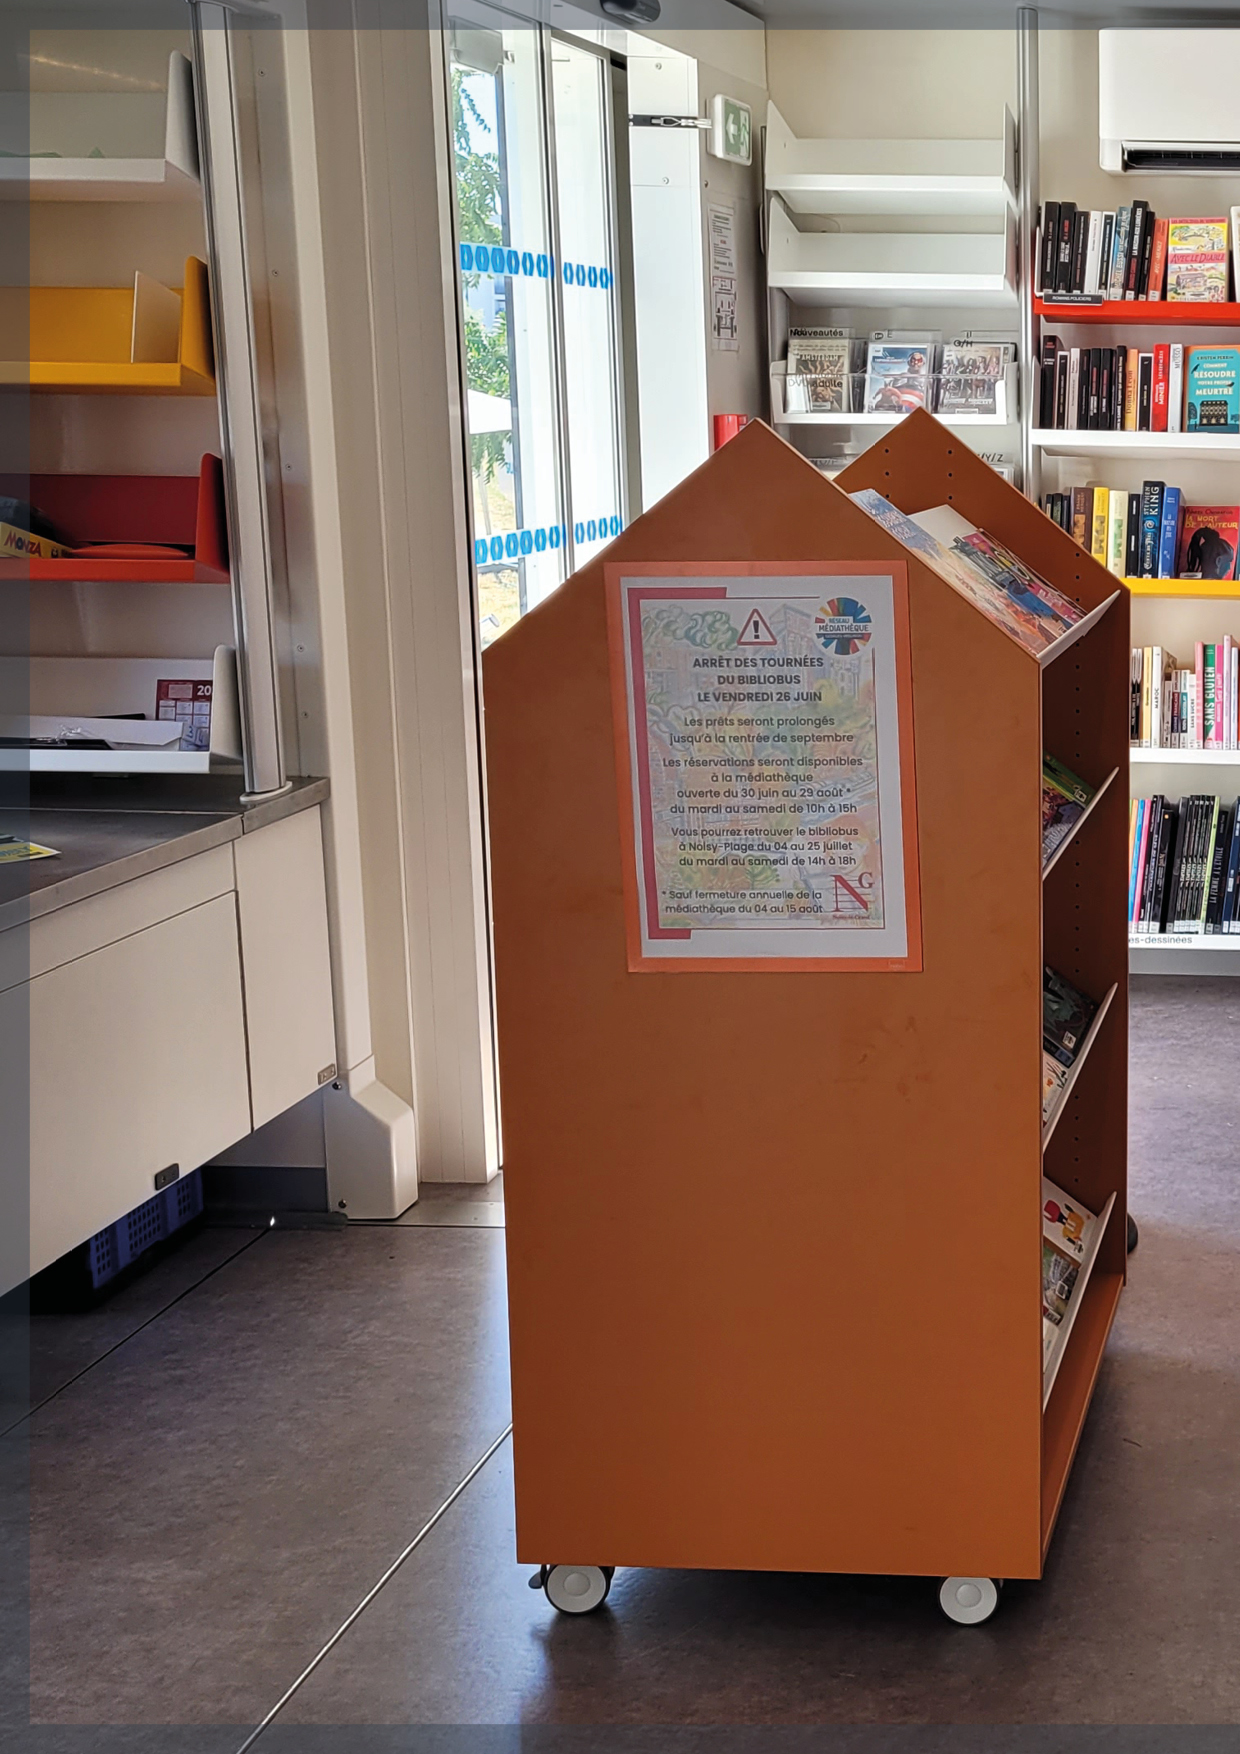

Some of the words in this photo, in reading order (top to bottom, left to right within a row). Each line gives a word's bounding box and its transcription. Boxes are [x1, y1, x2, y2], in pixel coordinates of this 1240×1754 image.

[1170, 254, 1187, 264] AVEC
[1188, 254, 1199, 263] LE
[1200, 253, 1225, 262] DIABLE
[790, 328, 844, 336] Nouveautés
[1196, 386, 1233, 395] MEURTRE
[1150, 487, 1159, 515] KING
[1199, 521, 1238, 529] L'AUTEUR
[4, 529, 42, 557] MONZA
[819, 623, 869, 631] MÉDIATHÈQUE
[693, 656, 731, 668] ARRÊT
[734, 658, 757, 667] DES
[762, 655, 823, 667] TOURNÉES
[718, 675, 734, 684] DU
[738, 675, 800, 684] BIBLIOBUS
[1205, 667, 1215, 698] GLUTEN
[698, 692, 710, 702] LE
[713, 692, 774, 701] VENDREDI
[776, 692, 791, 701] 26
[794, 692, 821, 701] JUIN
[1204, 703, 1215, 725] SANS
[684, 717, 702, 727] Les
[706, 717, 734, 729] prêts
[738, 717, 774, 726] seront
[777, 716, 835, 728] prolongés
[670, 734, 711, 746] jusqu'à
[715, 734, 725, 743] la
[729, 734, 769, 743] rentrée
[773, 734, 787, 743] de
[790, 733, 853, 745] septembre
[663, 758, 681, 767] Les
[684, 757, 755, 767] réservations
[758, 757, 794, 766] seront
[797, 756, 863, 768] disponibles
[711, 773, 719, 782] à
[722, 773, 732, 782] la
[736, 772, 813, 784] médiathèque
[677, 789, 720, 798] ouverte
[723, 788, 738, 798] du
[741, 789, 755, 798] 30
[758, 788, 778, 800] juin
[782, 789, 796, 798] au
[800, 788, 813, 797] 29
[817, 788, 843, 797] août
[670, 804, 685, 814] du
[688, 804, 721, 814] mardi
[725, 805, 739, 813] au
[743, 804, 785, 813] samedi
[789, 804, 803, 813] de
[806, 804, 825, 813] 10h
[828, 803, 835, 813] à
[839, 803, 857, 813] 15h
[671, 827, 698, 836] Vous
[701, 828, 742, 839] pourrez
[744, 828, 793, 836] retrouver
[796, 827, 805, 836] le
[809, 827, 858, 836] bibliobus
[679, 841, 686, 851] à
[689, 842, 754, 853] Noisy-Plage
[757, 842, 772, 851] du
[774, 842, 787, 851] 04
[790, 842, 805, 851] au
[808, 842, 820, 850] 25
[823, 841, 853, 853] juillet
[679, 857, 694, 866] du
[697, 856, 728, 866] mardi
[732, 857, 746, 866] au
[748, 856, 789, 865] samedi
[792, 856, 805, 865] de
[808, 856, 826, 865] 14h
[829, 856, 835, 865] à
[839, 856, 856, 865] 18h
[669, 891, 692, 899] Sauf
[695, 891, 746, 899] fermeture
[749, 891, 794, 899] annuelle
[797, 890, 809, 899] de
[812, 890, 822, 899] la
[666, 904, 736, 915] médiathèque
[739, 904, 752, 913] du
[754, 905, 768, 913] 04
[770, 905, 783, 913] au
[786, 905, 796, 913] 15
[799, 904, 823, 913] août
[1129, 935, 1193, 944] es-dessinées
